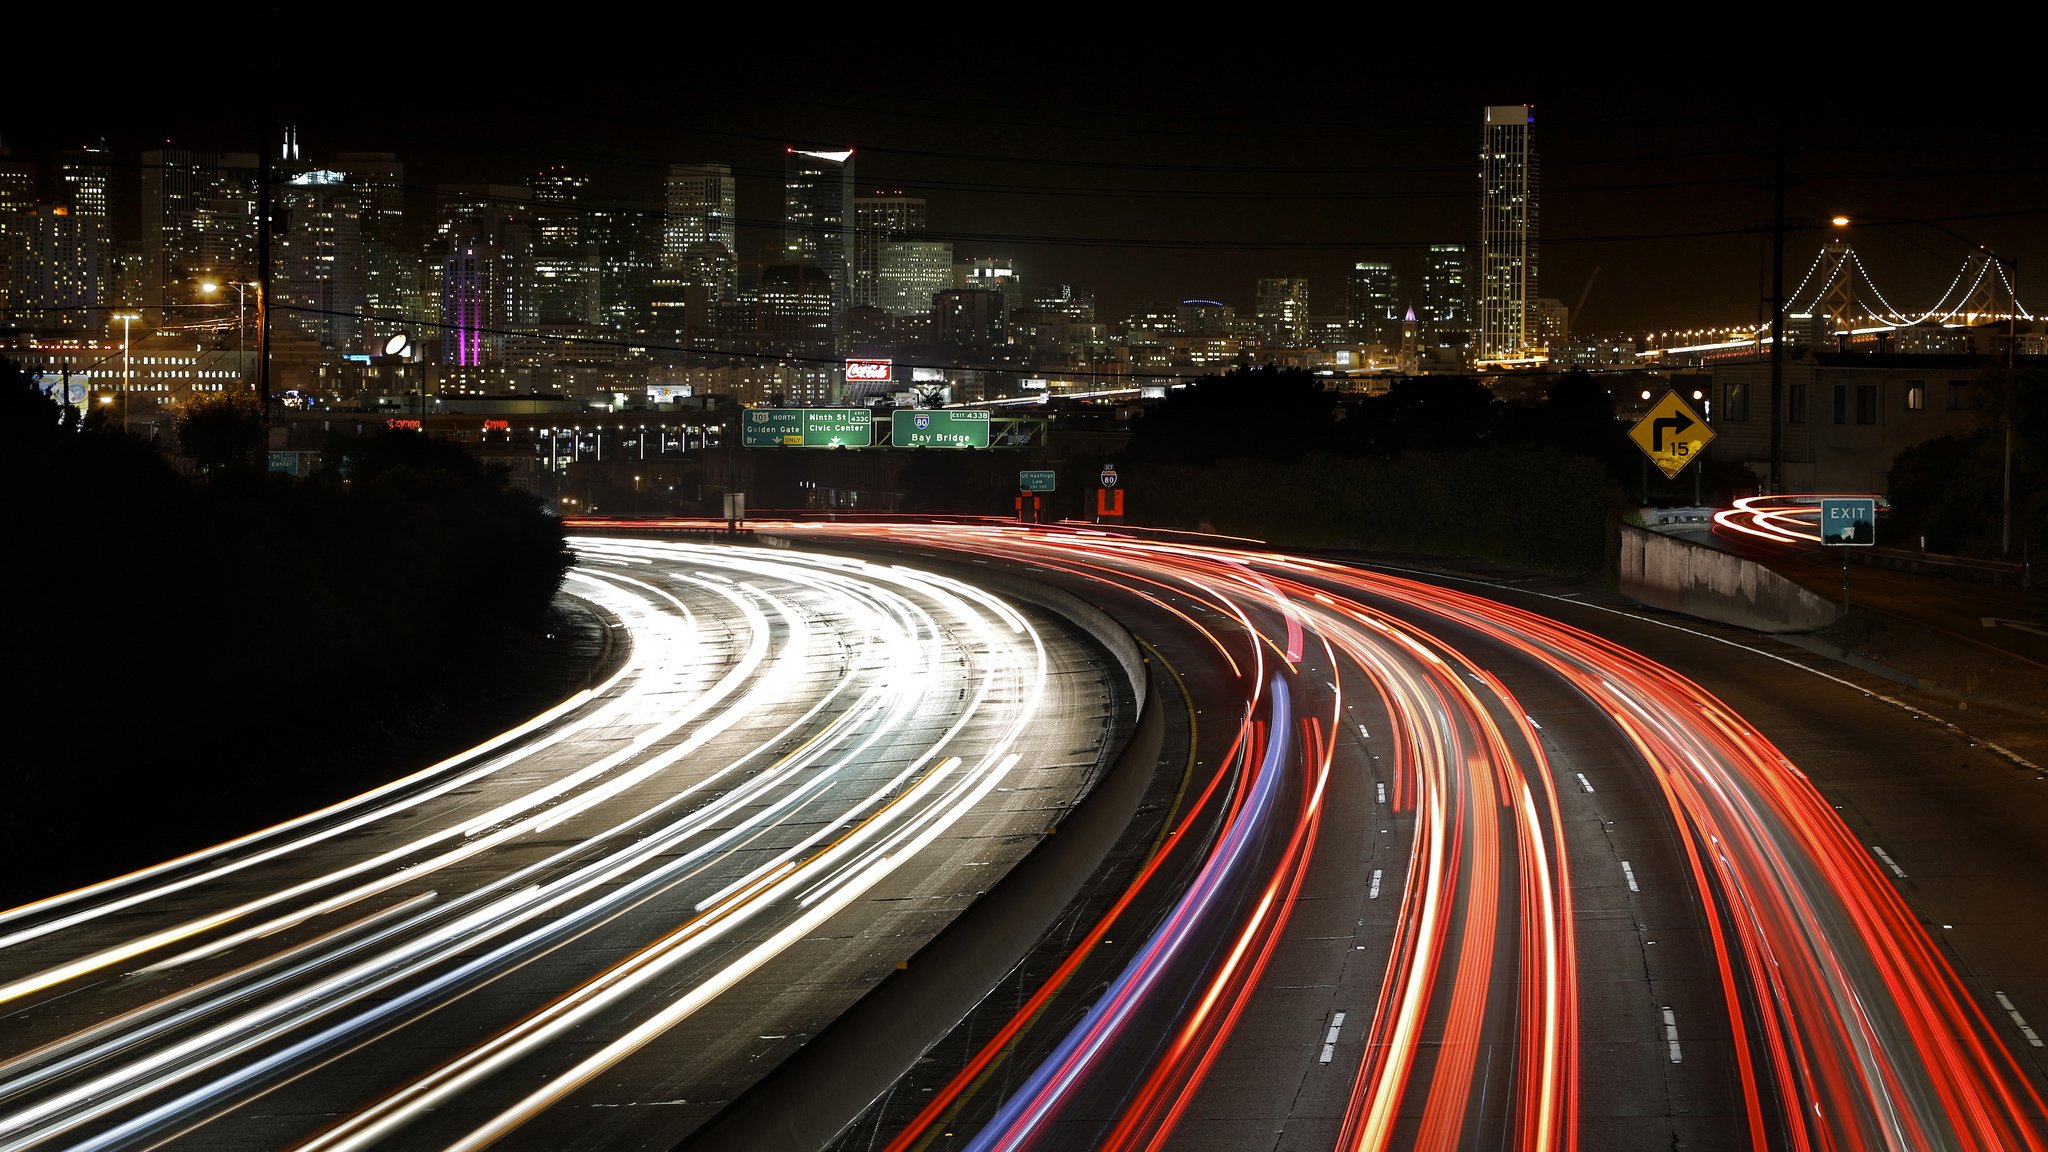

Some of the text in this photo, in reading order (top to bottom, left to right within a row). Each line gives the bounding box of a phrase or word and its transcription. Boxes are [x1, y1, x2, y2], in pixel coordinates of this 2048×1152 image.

[755, 413, 768, 421] 101
[917, 418, 928, 426] 80
[809, 424, 864, 432] Civic Center
[911, 433, 970, 444] Bay Bridge
[1671, 442, 1689, 456] 15
[1831, 508, 1865, 518] EXIT
